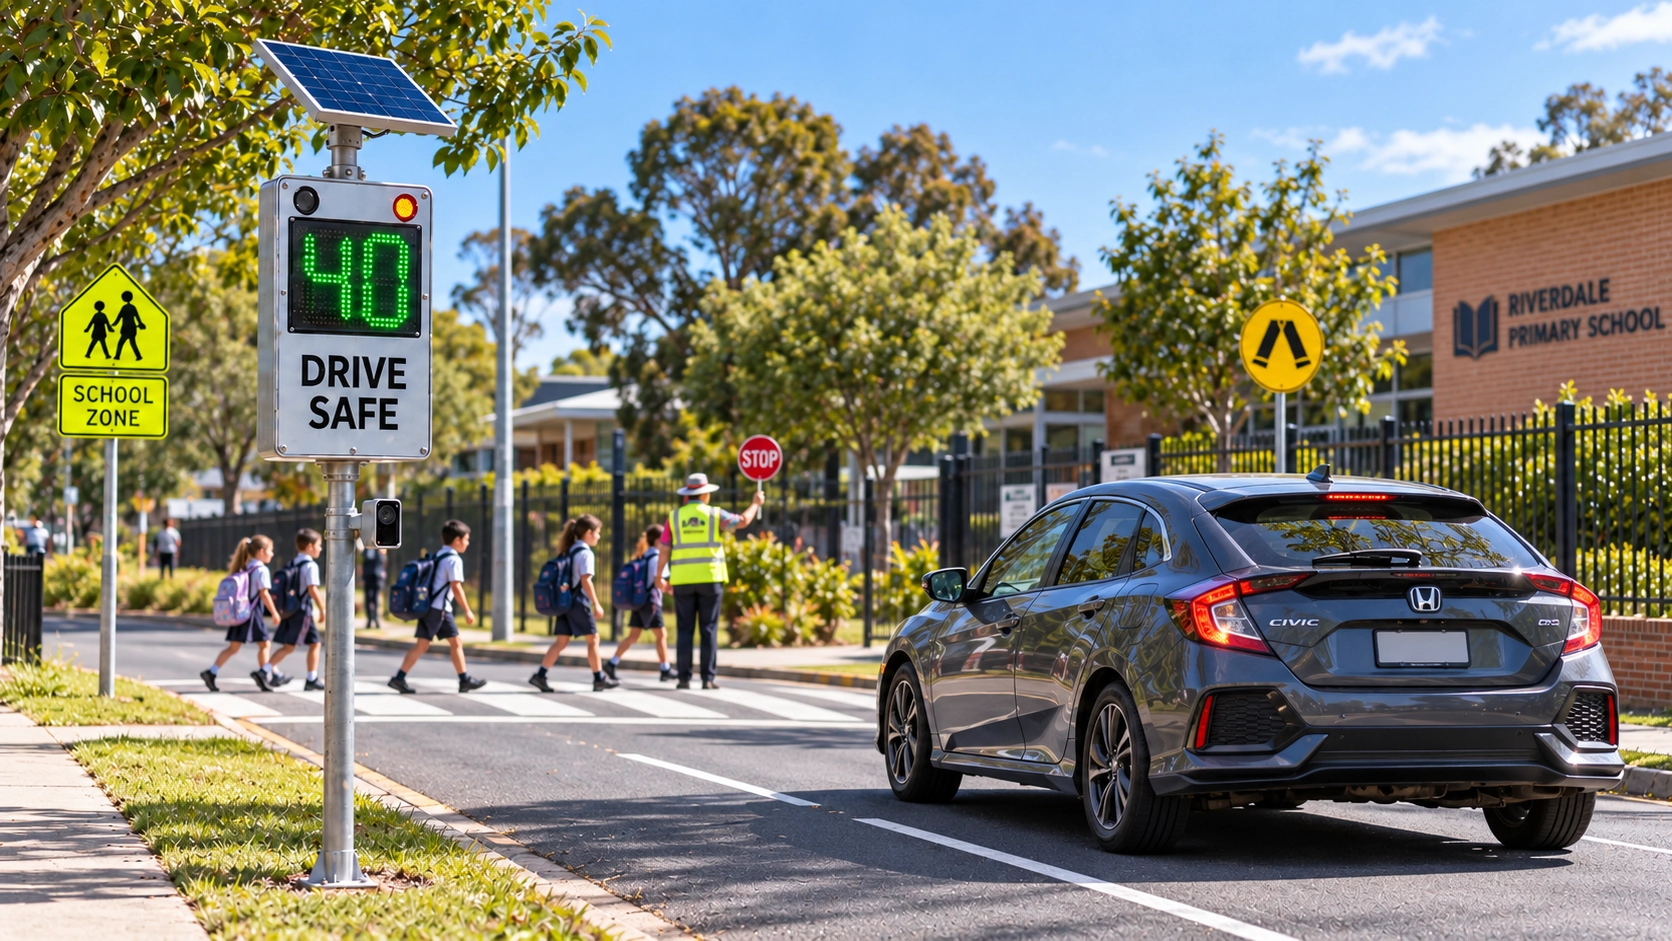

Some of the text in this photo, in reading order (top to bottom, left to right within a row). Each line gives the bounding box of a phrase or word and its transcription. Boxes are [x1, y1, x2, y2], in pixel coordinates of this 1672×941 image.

[303, 232, 409, 329] 40
[1508, 278, 1610, 317] RIVERDALE
[1508, 306, 1666, 349] PRIMARY SCHOOL
[301, 354, 407, 390] DRIVE
[73, 384, 154, 405] SCHOOL
[86, 408, 140, 427] ZONE
[308, 396, 399, 431] SAFE
[742, 449, 778, 468] STOP
[1269, 618, 1320, 627] CIVIC
